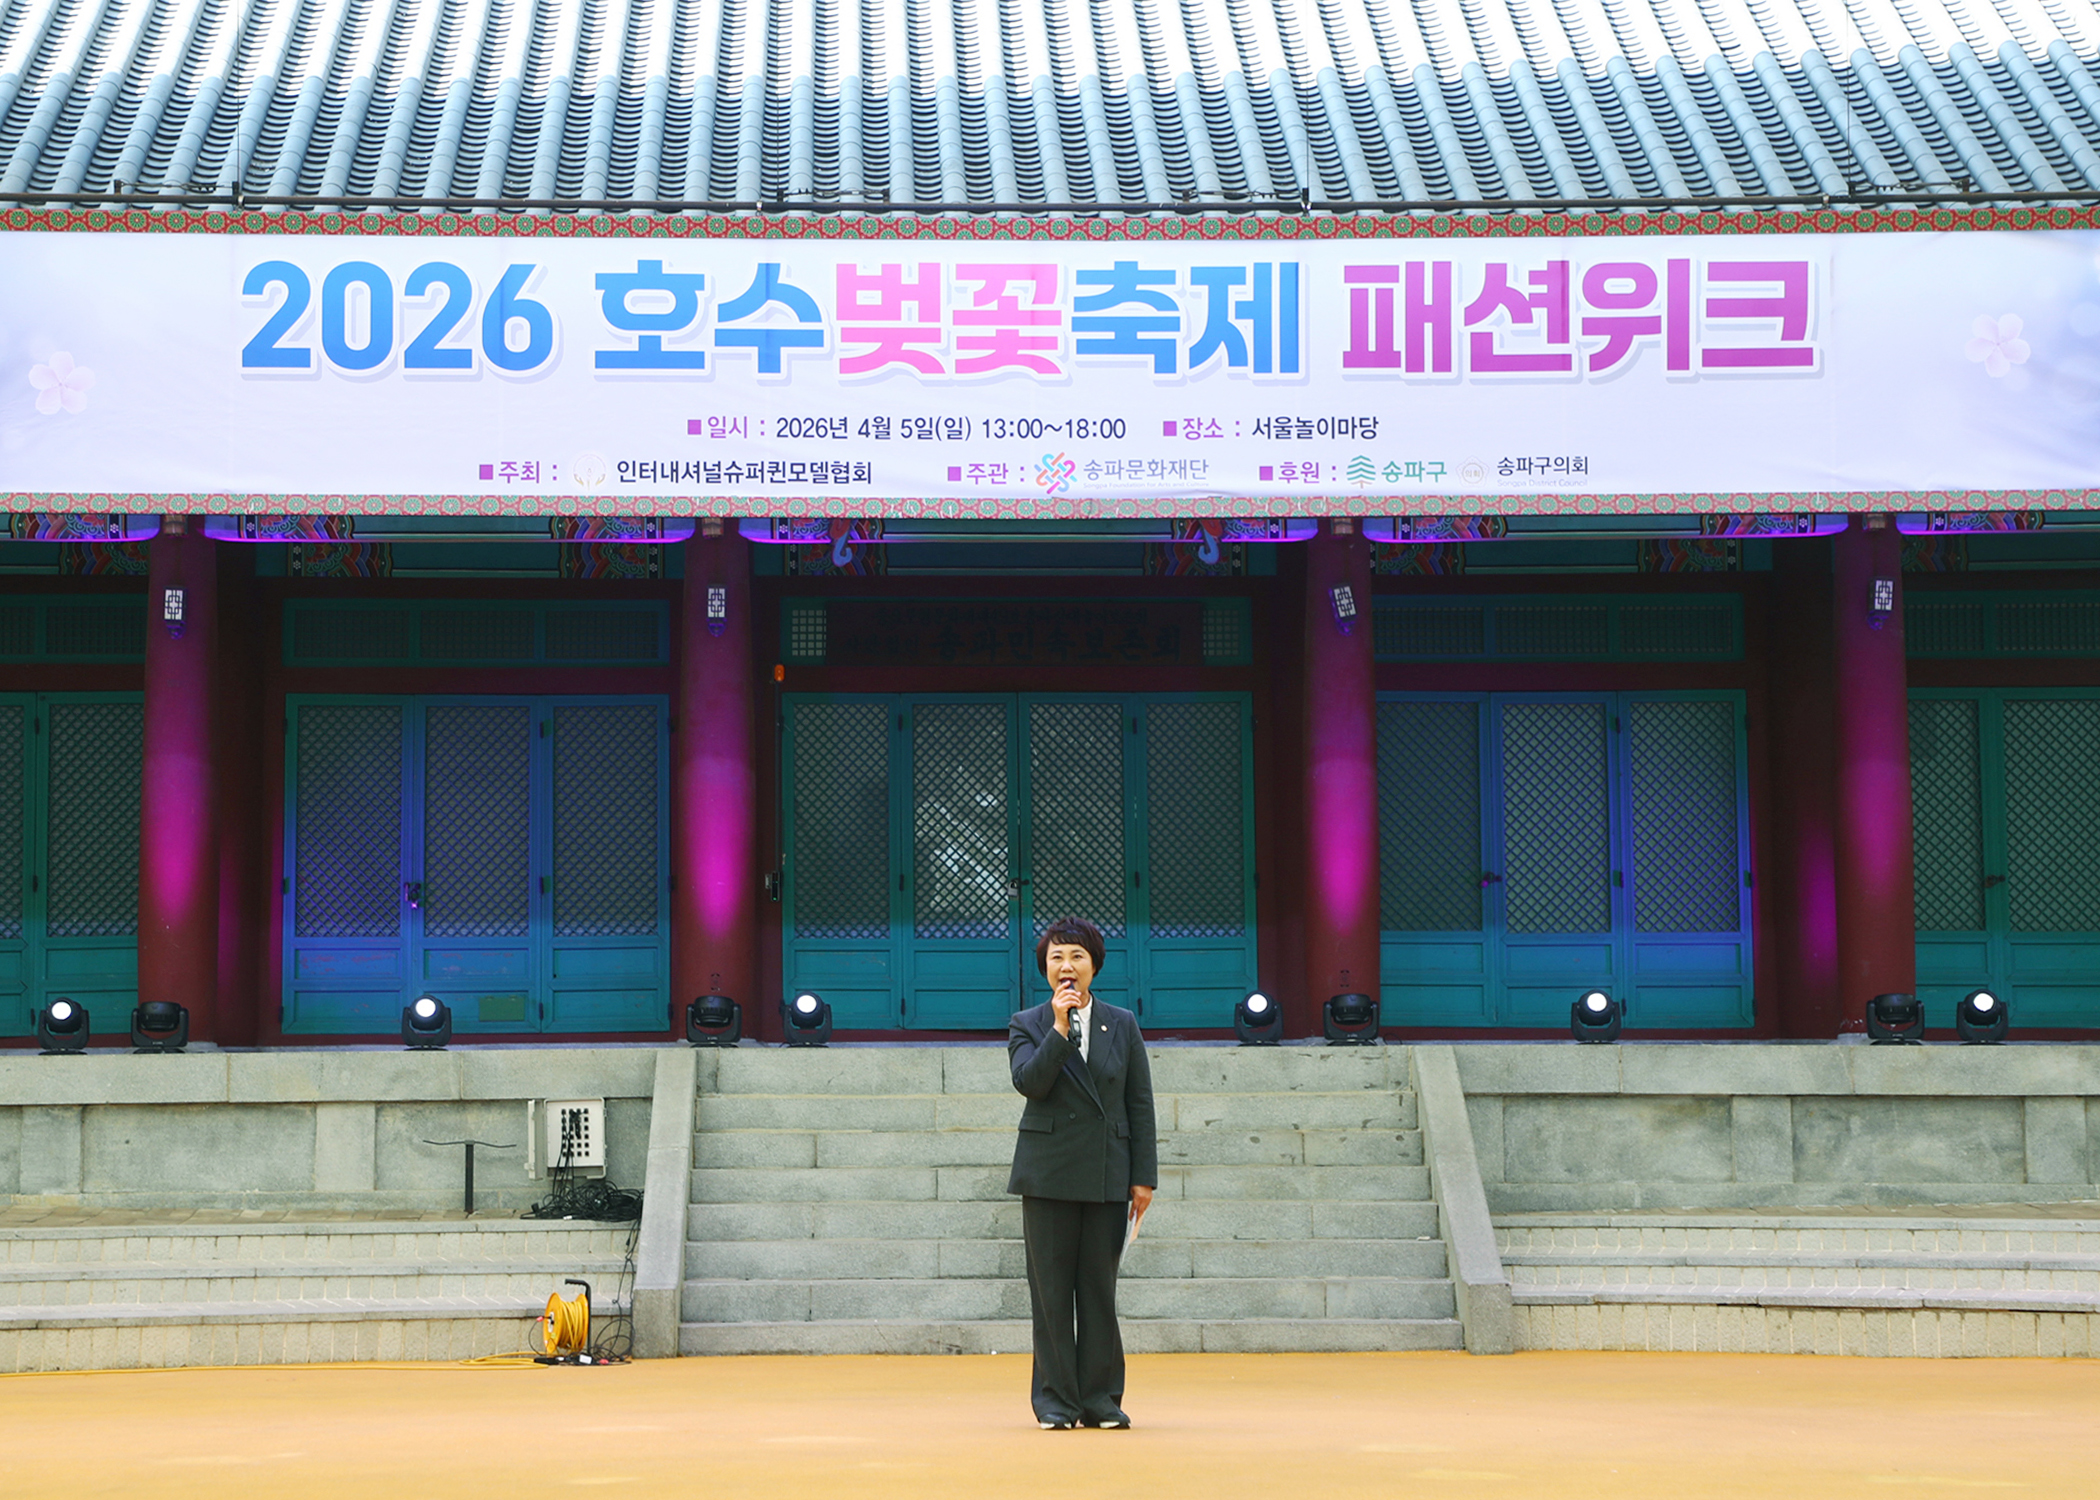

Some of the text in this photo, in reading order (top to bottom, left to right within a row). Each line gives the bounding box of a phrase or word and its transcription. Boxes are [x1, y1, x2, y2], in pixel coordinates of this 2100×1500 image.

[242, 259, 1814, 374] 2026 호수벚꽃축제 패션위크
[708, 416, 748, 439] 일시
[777, 416, 849, 440] 2026년
[858, 416, 891, 440] 4월
[901, 416, 972, 441] 5일(일)
[983, 417, 1127, 440] 13:00~18:00
[1183, 416, 1225, 440] 장소
[1252, 415, 1380, 440] 서울놀이마당
[499, 461, 540, 484] 주최
[617, 460, 872, 485] 인터내셔널슈퍼퀸모델협회
[967, 463, 1009, 486] 주관
[1084, 459, 1209, 481] 송파문화재단
[1278, 461, 1320, 484] 후원
[1381, 460, 1448, 482] 송파구
[1497, 456, 1589, 477] 송파구의회
[1497, 479, 1588, 487] Songpa District Council
